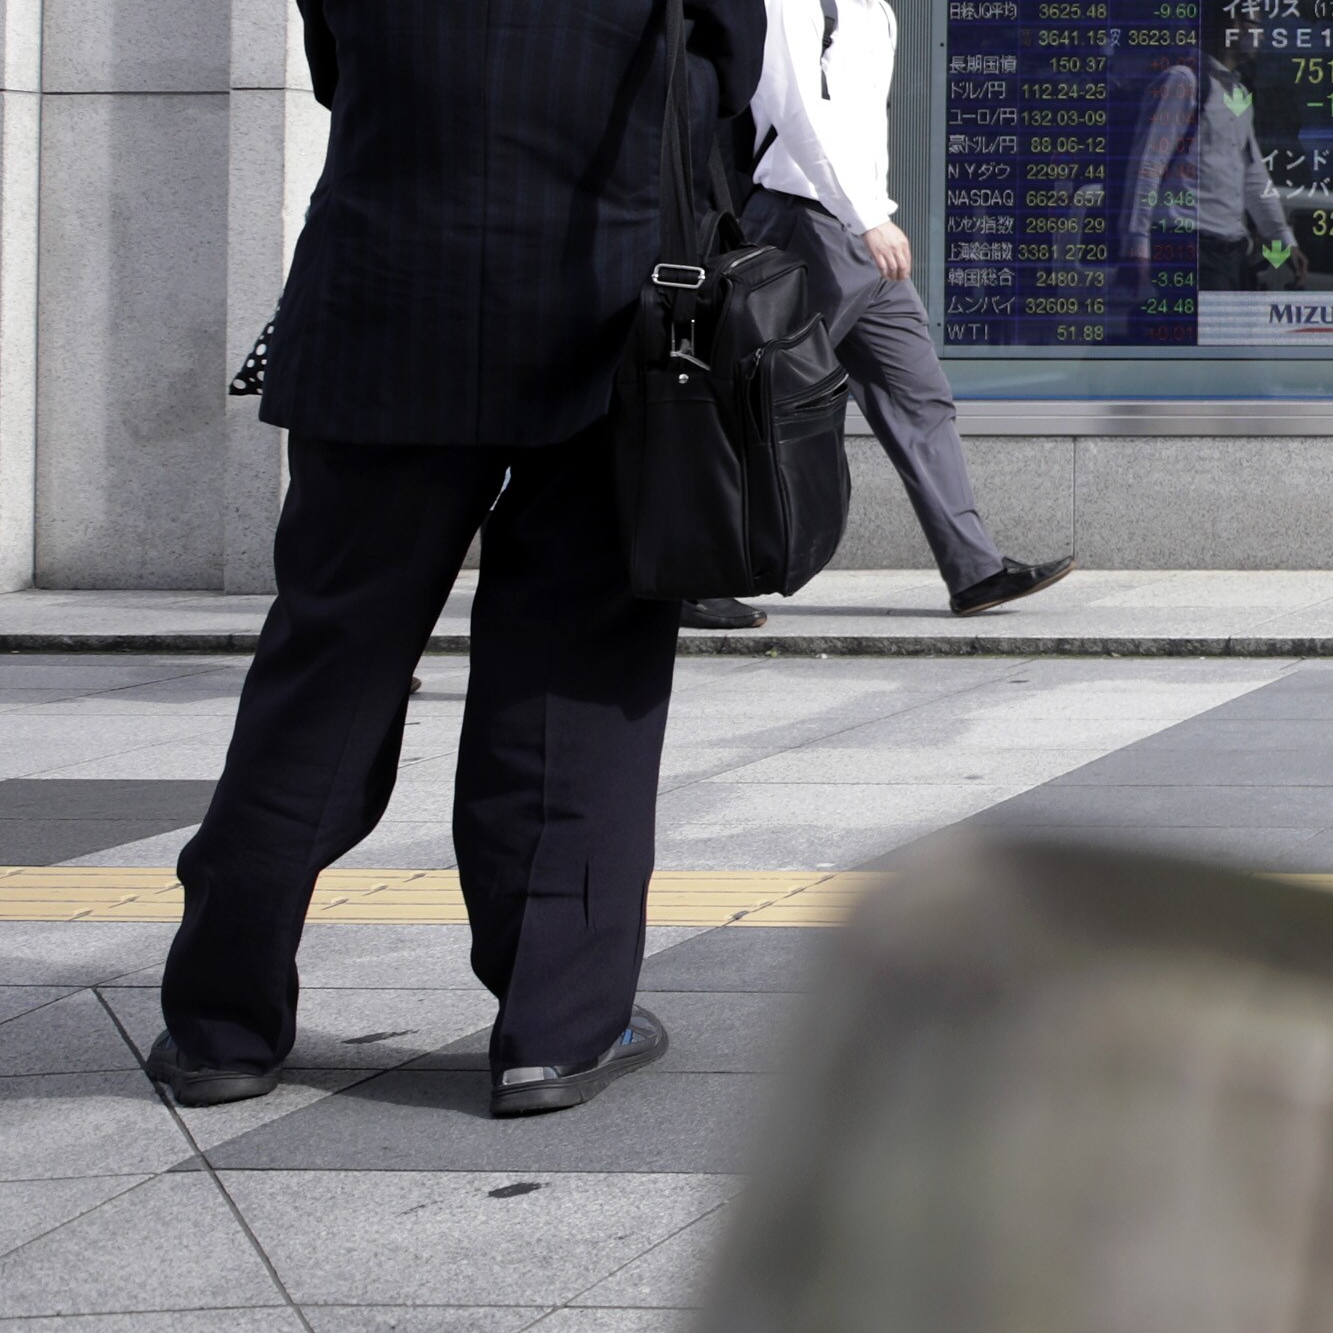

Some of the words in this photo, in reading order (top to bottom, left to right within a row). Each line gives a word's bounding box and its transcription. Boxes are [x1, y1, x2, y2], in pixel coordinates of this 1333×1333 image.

[950, 1, 1017, 20] 日経JQ平均
[1038, 3, 1107, 19] 3625.48
[1153, 3, 1197, 18] -9.60
[1038, 30, 1107, 46] 3641.15
[1128, 30, 1197, 46] 3623.64
[1049, 57, 1107, 73] 150.37
[950, 81, 1006, 100] ドル/円
[1022, 83, 1107, 99] 112.24-25
[949, 108, 1018, 126] ユーロ/円
[1022, 110, 1107, 126] 132.03-09
[1030, 137, 1106, 153] 88.06-12
[1260, 149, 1330, 171] インド
[1026, 164, 1106, 180] 22997.44
[947, 189, 1015, 207] NASDAQ
[1026, 190, 1105, 207] 6623.657
[1025, 217, 1105, 233] 28696.29
[1017, 244, 1107, 260] 3381.2720
[947, 268, 1016, 288] 韓国総合
[1036, 271, 1105, 287] 2480.73
[1151, 271, 1195, 287] -3.64
[947, 295, 1016, 315] ムンバイ
[1025, 297, 1105, 314] 32609.16
[1139, 298, 1195, 314] -24.48
[947, 323, 989, 340] WTI
[1056, 325, 1105, 341] 51.88
